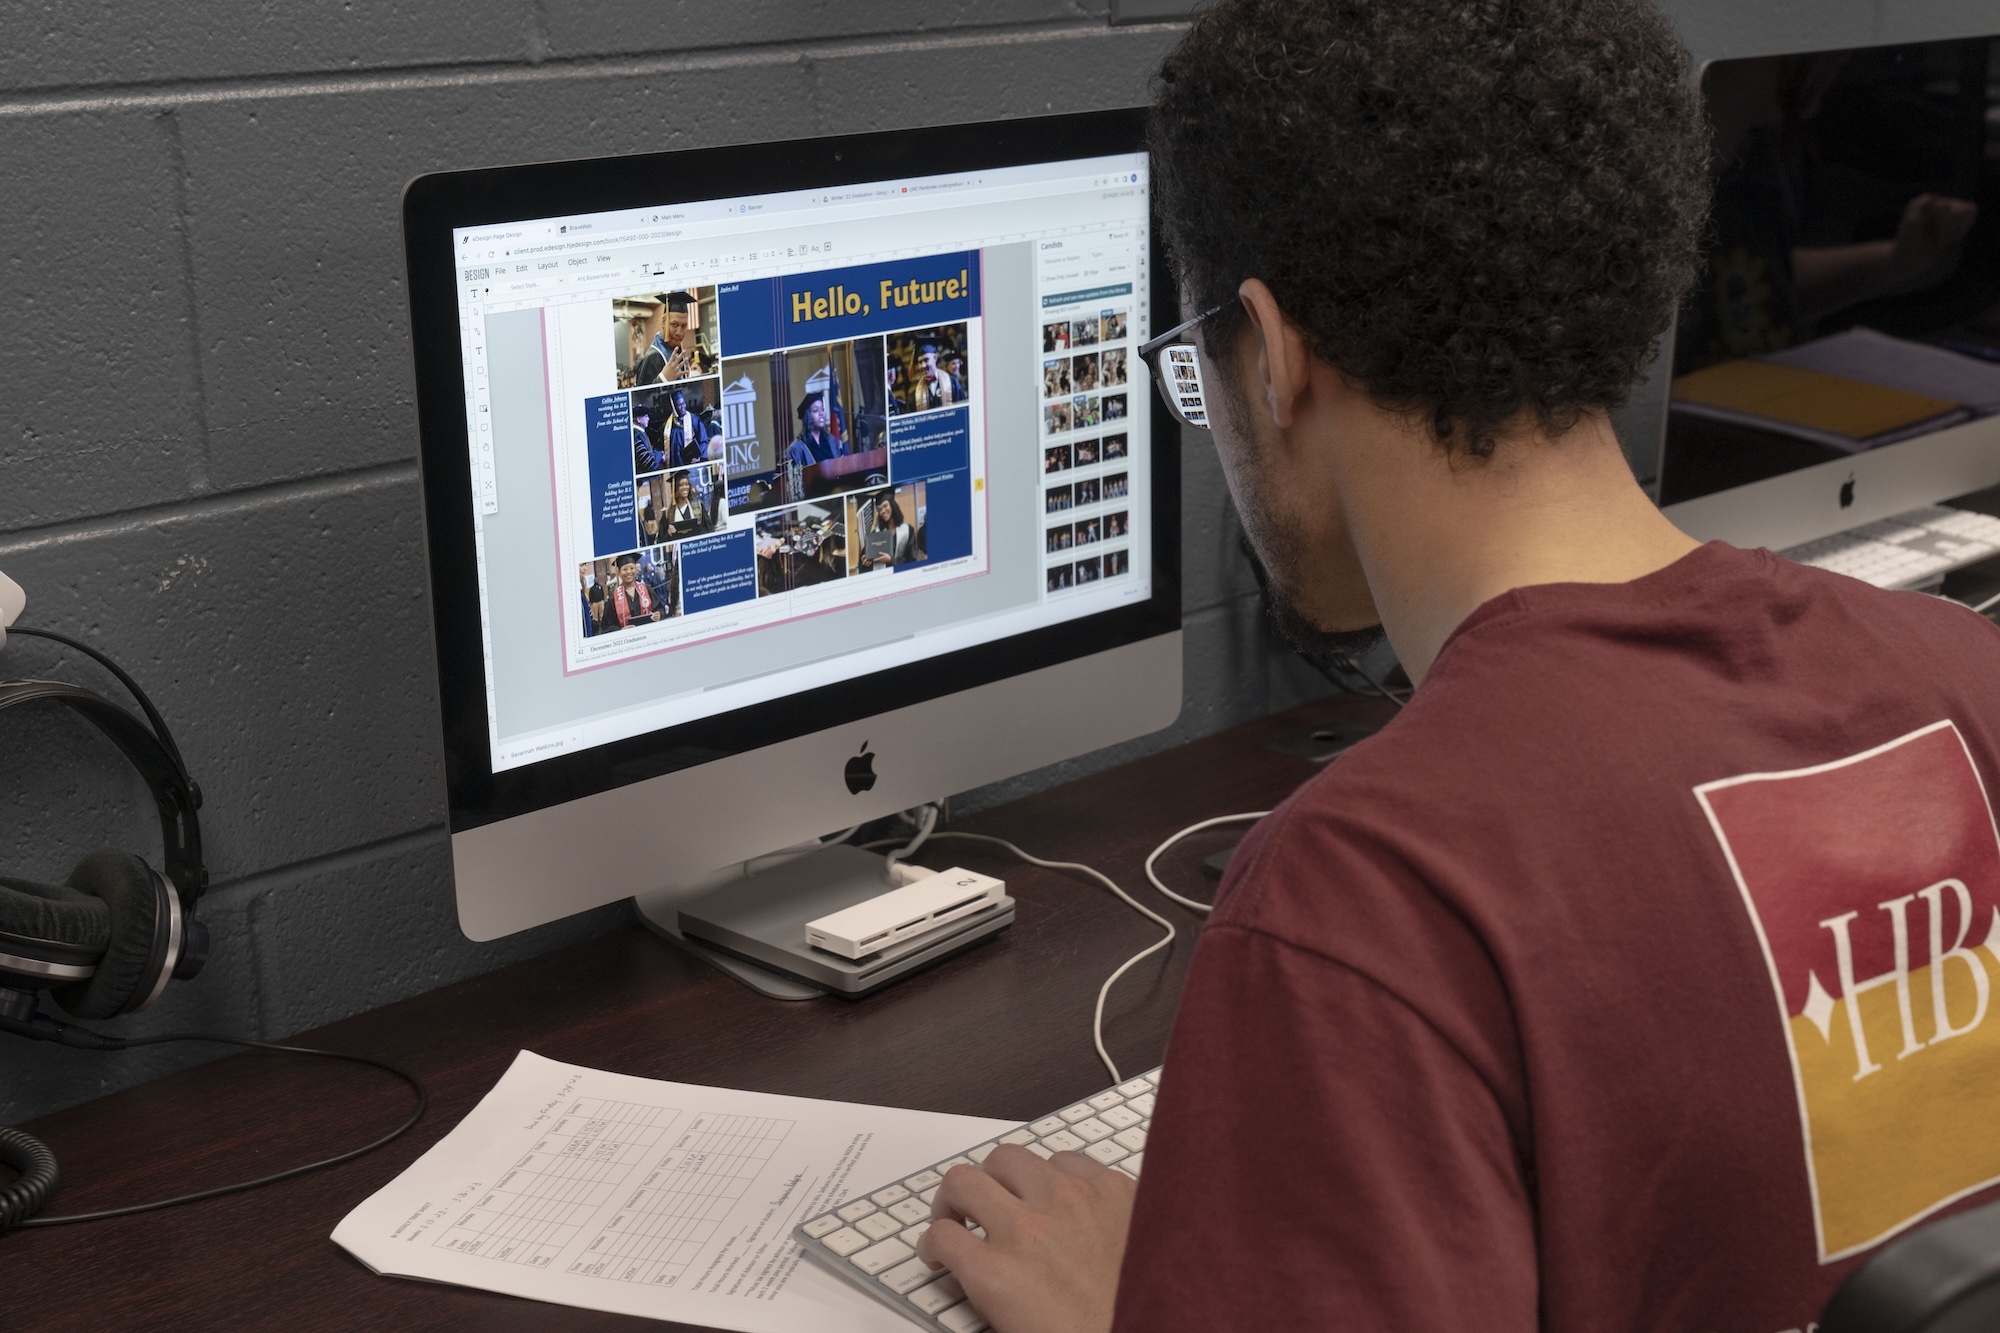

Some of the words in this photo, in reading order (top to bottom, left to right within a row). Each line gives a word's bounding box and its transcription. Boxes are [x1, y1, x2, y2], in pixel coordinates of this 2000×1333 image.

[505, 231, 522, 239] Design
[1041, 240, 1063, 250] Candids
[495, 267, 506, 275] File
[516, 264, 528, 273] Edit
[538, 261, 558, 271] Layout
[568, 257, 588, 267] Object
[597, 254, 611, 262] View
[791, 285, 870, 323] Hello,
[880, 269, 968, 310] Future!
[590, 643, 612, 653] December
[613, 639, 623, 647] 2022
[623, 635, 647, 645] Graduation
[457, 1213, 476, 1226] Monday
[477, 1194, 495, 1207] Tuesday
[496, 1170, 519, 1189] Wednesday
[516, 1155, 534, 1168] Thursday
[534, 1140, 548, 1151] Friday
[589, 1236, 607, 1251] Monday
[607, 1215, 625, 1229] Tuesday
